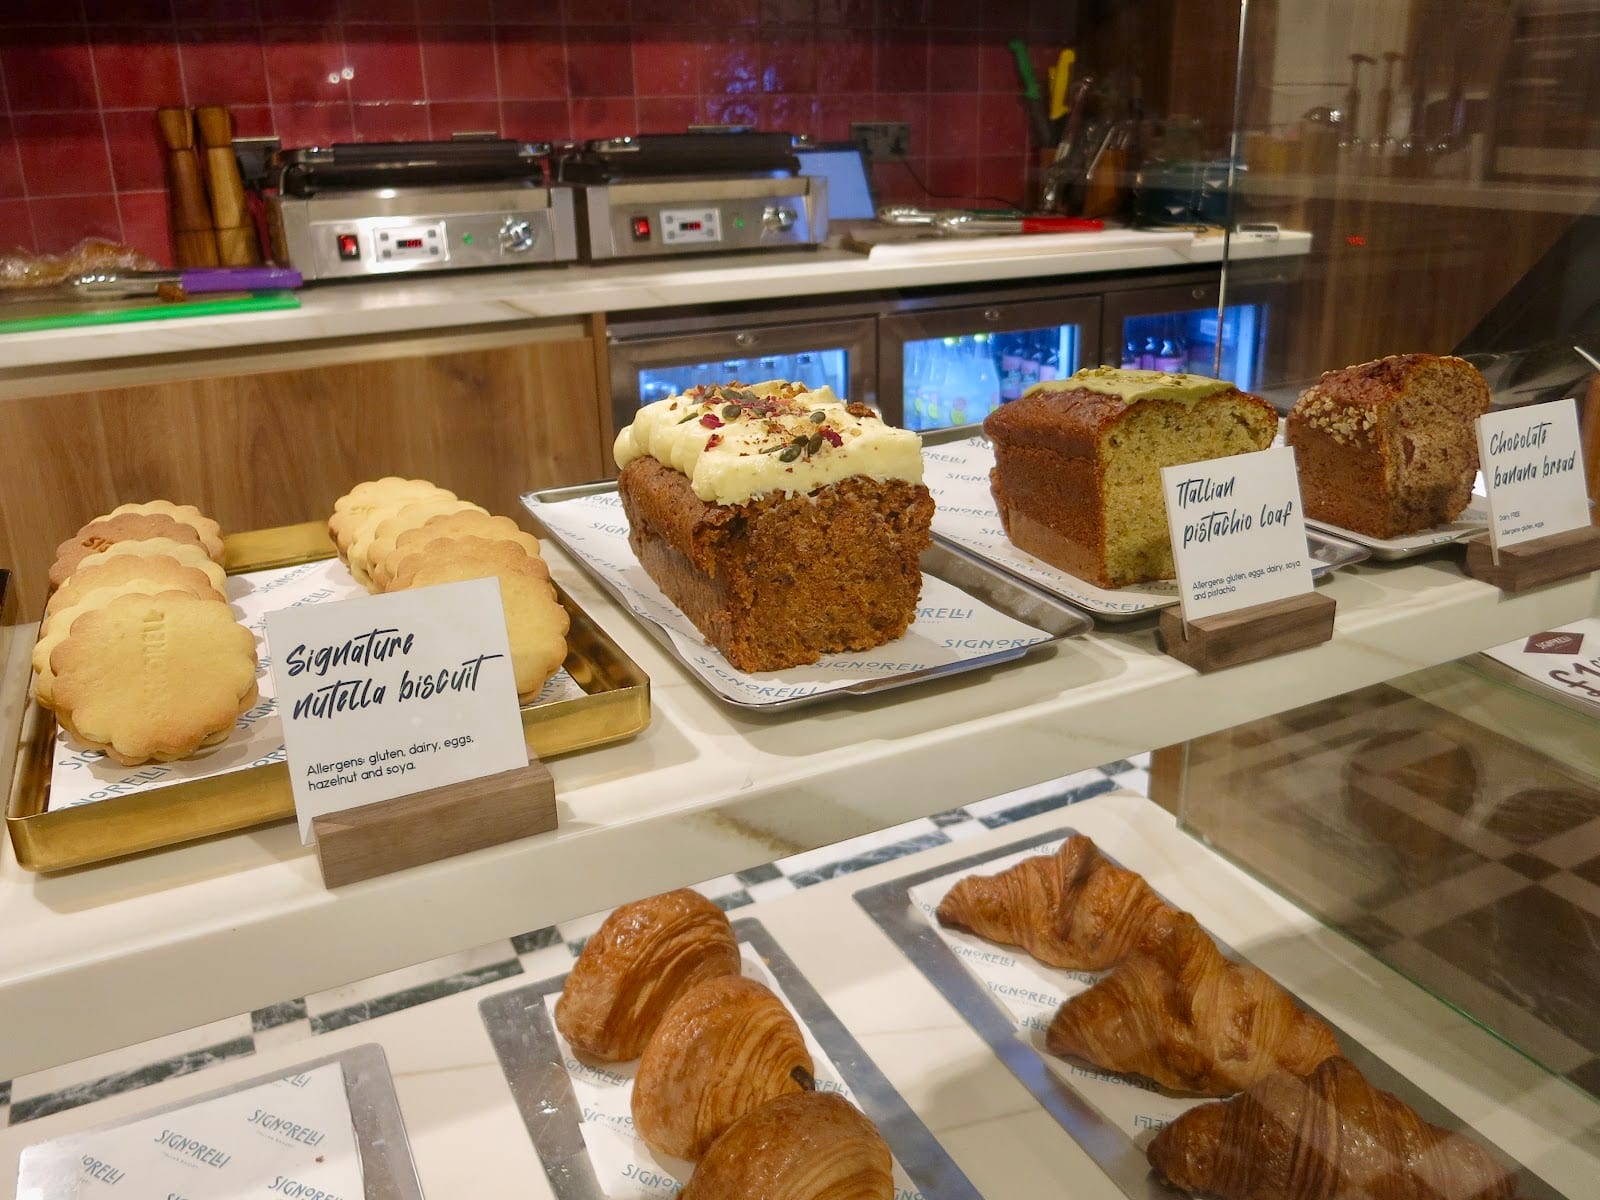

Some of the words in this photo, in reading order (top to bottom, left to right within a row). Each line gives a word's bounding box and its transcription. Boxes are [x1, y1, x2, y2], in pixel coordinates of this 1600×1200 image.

[1489, 421, 1553, 456] Chocolate
[1493, 462, 1537, 489] banana
[1542, 450, 1576, 478] bread
[1183, 508, 1253, 549] pistachio
[1260, 501, 1293, 529] loaf
[1194, 591, 1207, 600] and
[1207, 585, 1236, 598] pistachio
[286, 628, 416, 677] Signature
[293, 678, 387, 720] nutella
[398, 654, 505, 703] biscuit
[694, 656, 818, 698] SIGNORELLI
[368, 749, 406, 766] gluten,
[409, 741, 441, 755] dairy,
[444, 735, 474, 749] eggs,
[308, 773, 357, 791] hazelnut
[361, 767, 383, 780] and
[386, 762, 417, 775] soya.
[247, 1109, 326, 1147] SIGNORELLI
[154, 1129, 232, 1169] SIGNORELLI
